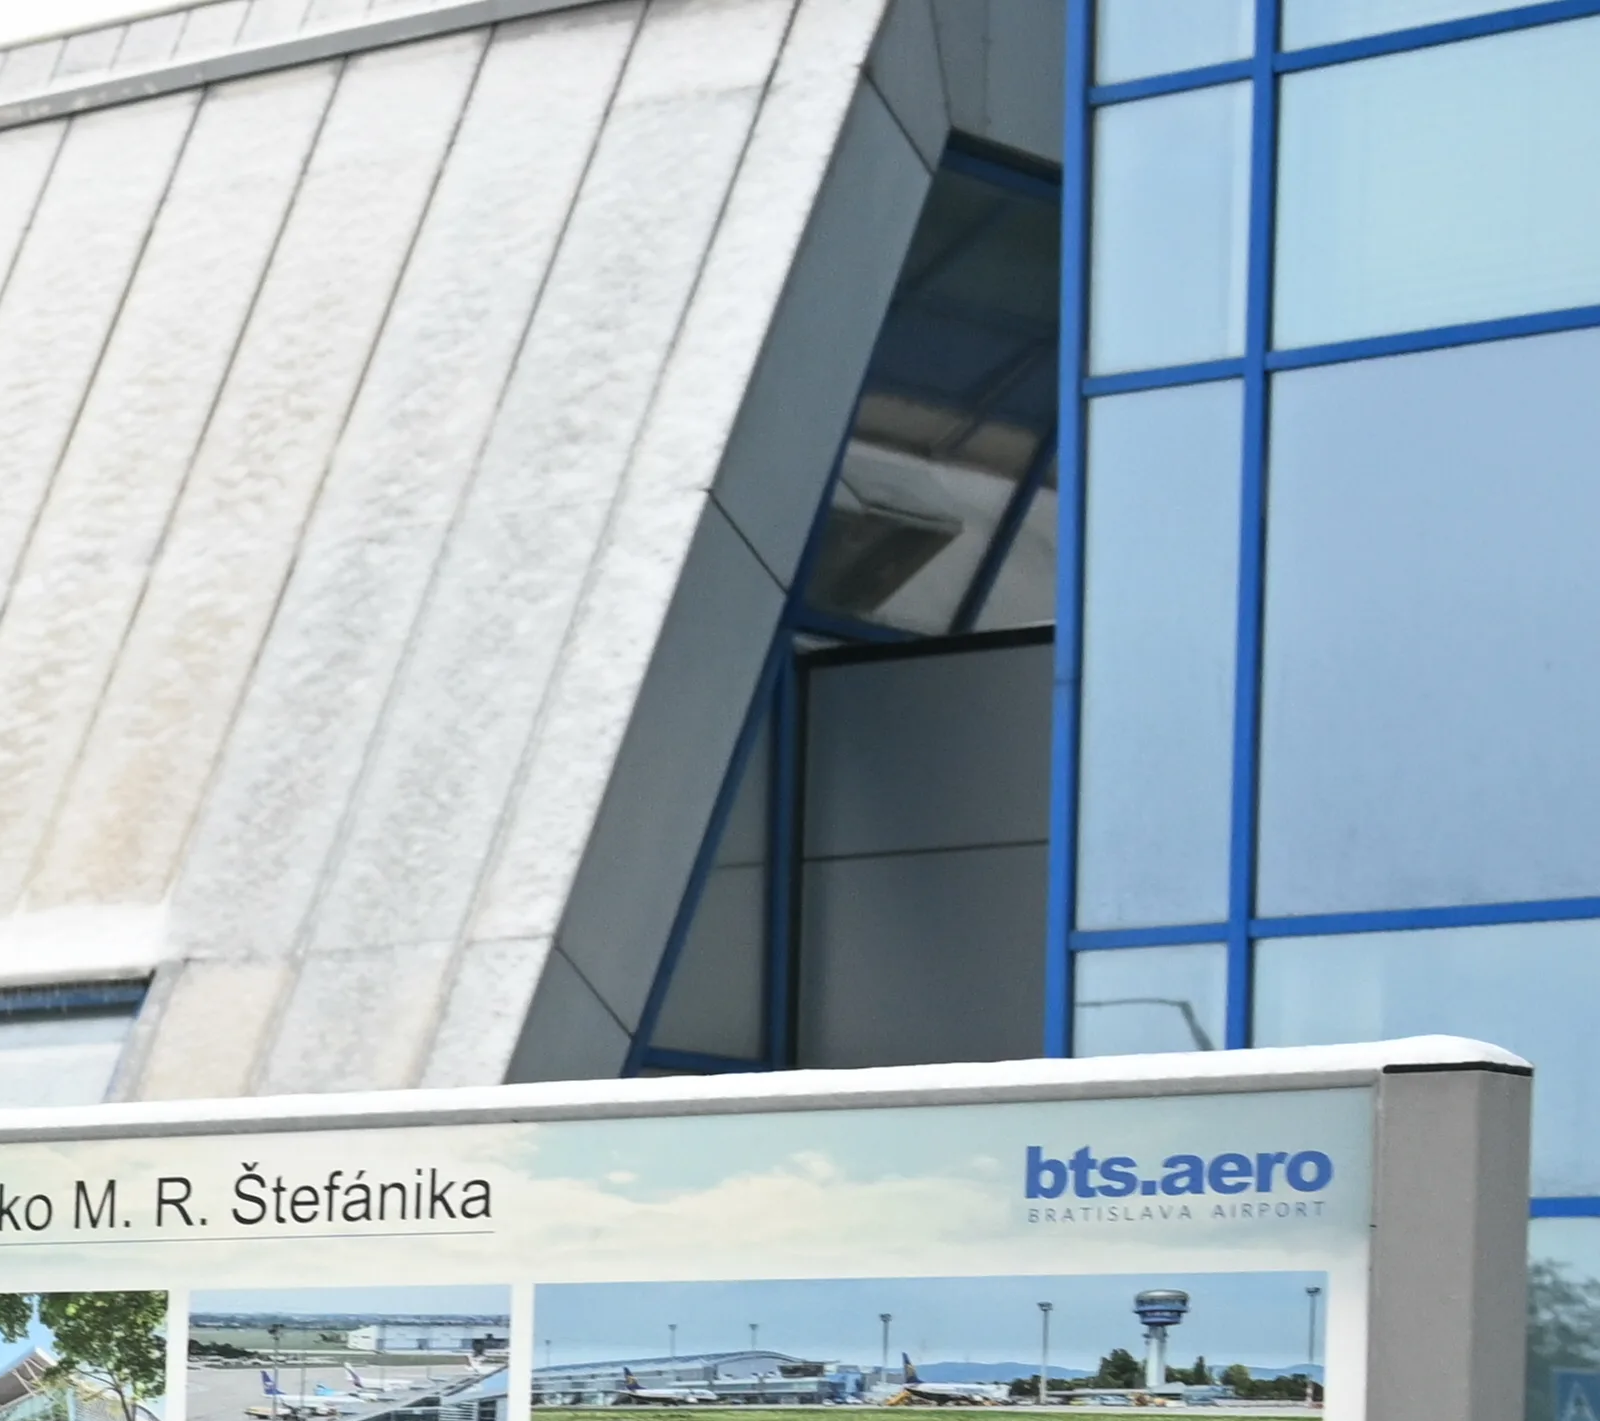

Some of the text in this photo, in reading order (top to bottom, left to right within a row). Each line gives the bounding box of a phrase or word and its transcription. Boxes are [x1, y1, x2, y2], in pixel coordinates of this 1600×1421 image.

[73, 1179, 131, 1230] M.
[156, 1176, 208, 1227] R.
[231, 1161, 494, 1225] Štefánika
[1025, 1145, 1333, 1199] bts.aero
[1027, 1200, 1326, 1224] BRATISLAVA AIRPORT
